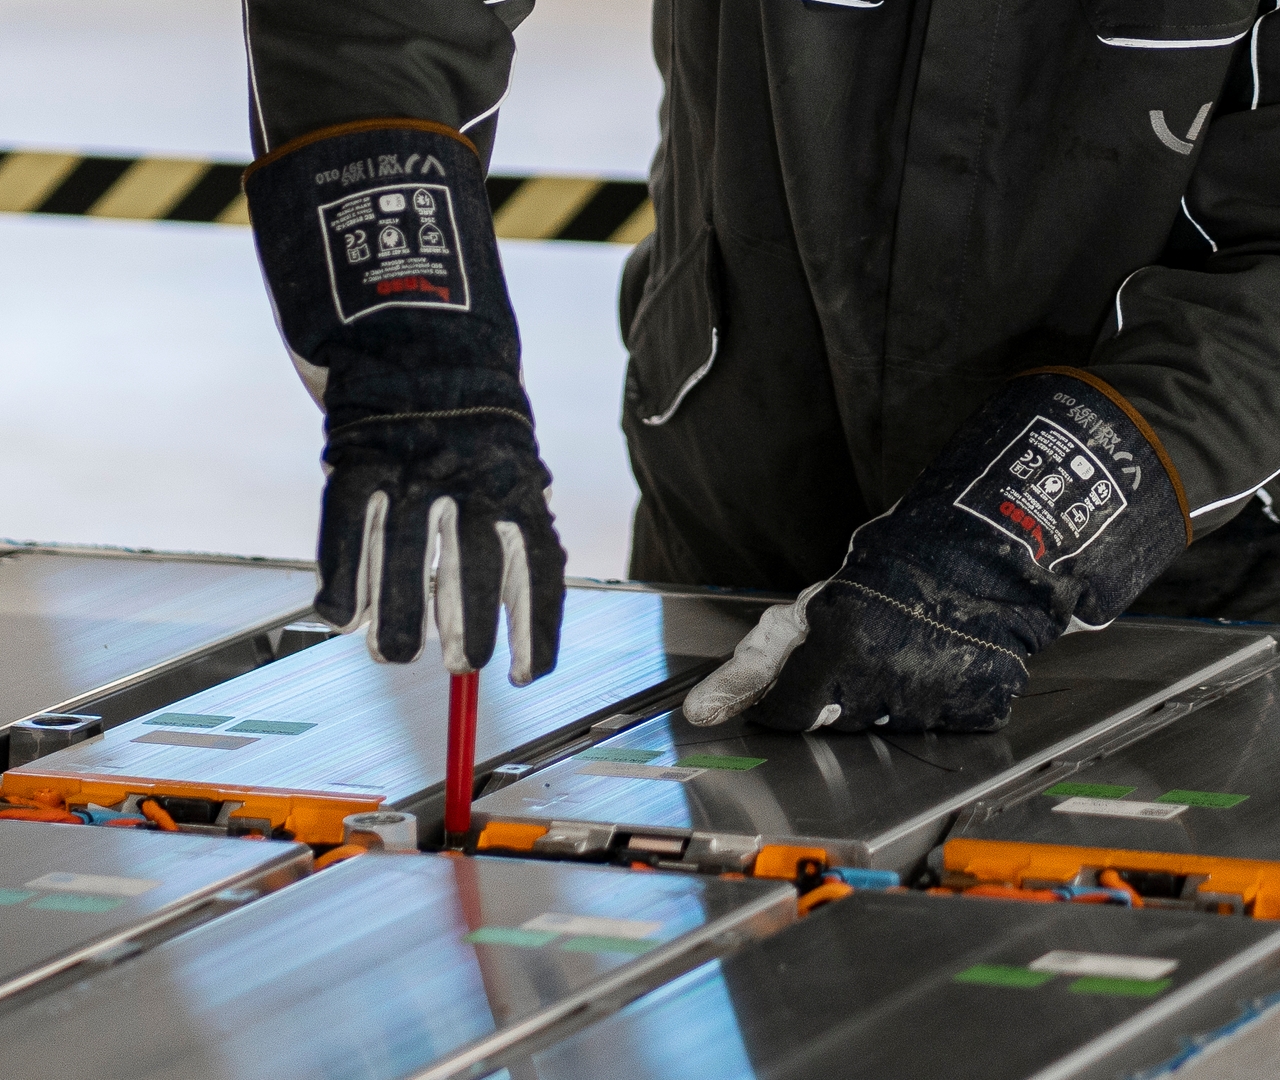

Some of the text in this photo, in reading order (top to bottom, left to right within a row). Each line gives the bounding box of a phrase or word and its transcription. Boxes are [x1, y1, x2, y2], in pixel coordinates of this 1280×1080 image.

[1053, 392, 1097, 422] 397 010
[1067, 408, 1090, 428] VAS
[1020, 449, 1042, 468] CE
